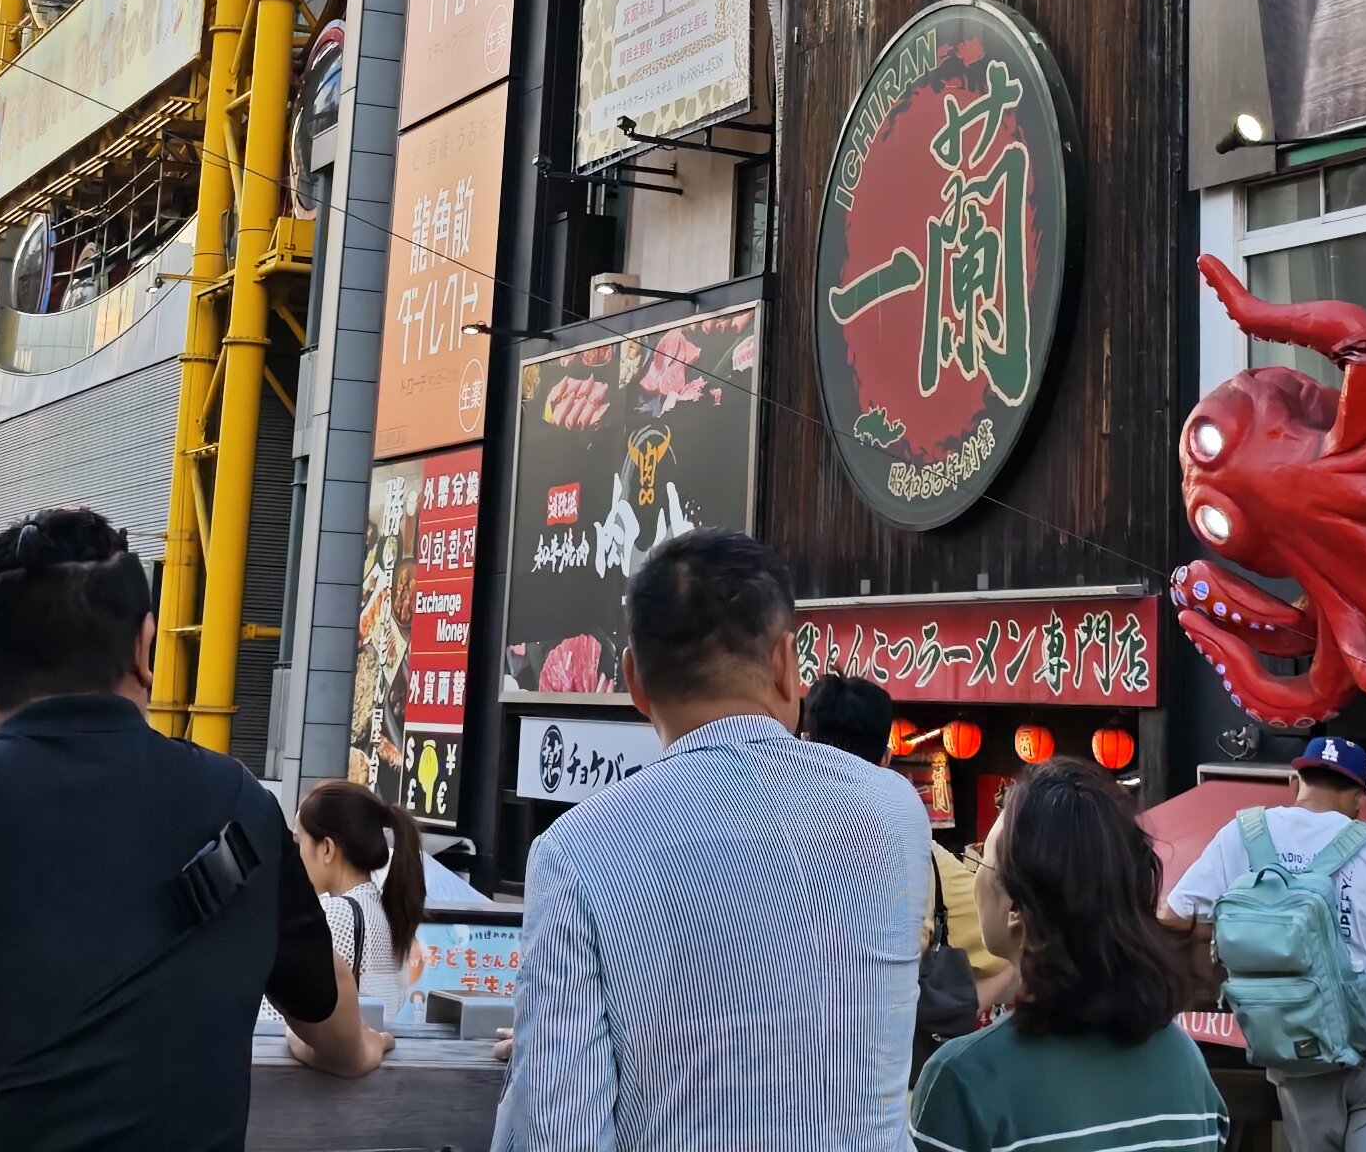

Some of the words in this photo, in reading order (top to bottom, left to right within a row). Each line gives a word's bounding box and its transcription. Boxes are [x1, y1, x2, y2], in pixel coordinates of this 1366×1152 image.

[835, 29, 938, 211] ICHIRAN
[409, 175, 475, 276] 龍角散
[829, 59, 1032, 408] 一蘭
[397, 270, 479, 365] ダイレクト
[458, 379, 482, 412] 生薬
[887, 418, 996, 503] 昭和35年創業
[423, 469, 480, 512] 外幣兌換
[417, 526, 476, 573] 외화환전
[415, 590, 463, 617] Exchange
[436, 617, 471, 647] Money
[567, 743, 643, 787] チョケバー
[1321, 740, 1339, 762] LA
